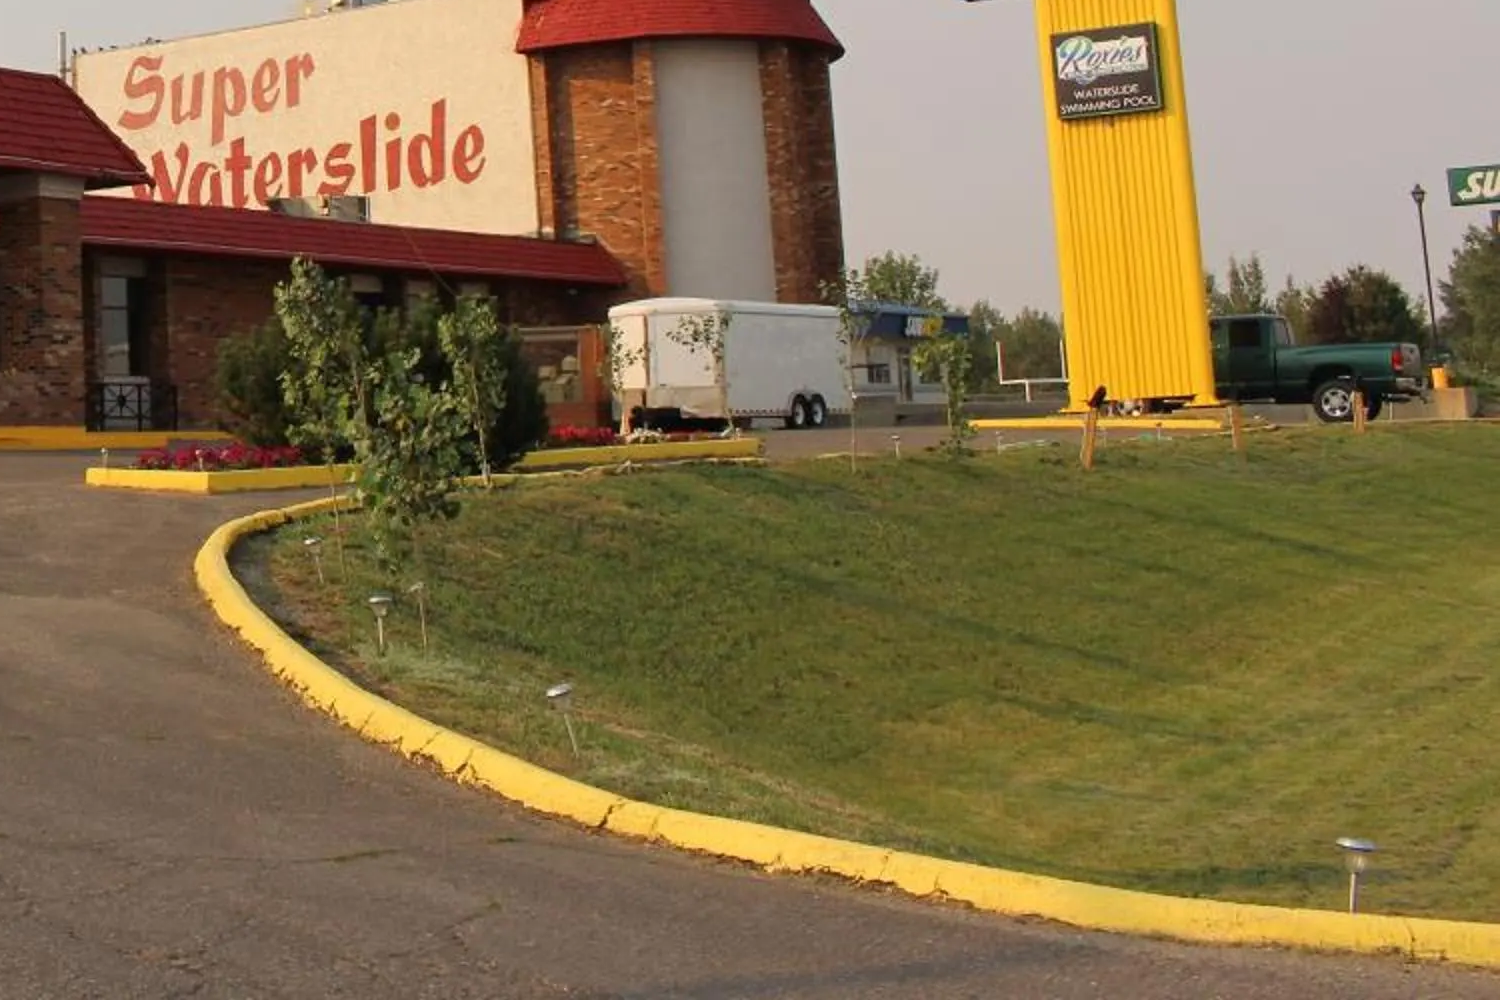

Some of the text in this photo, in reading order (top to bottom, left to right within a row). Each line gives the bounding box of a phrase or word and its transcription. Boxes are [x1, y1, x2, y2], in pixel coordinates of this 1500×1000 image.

[117, 52, 316, 146] Super
[1074, 84, 1138, 99] WATERSLIDE
[1060, 96, 1156, 114] SWIMMING POOL
